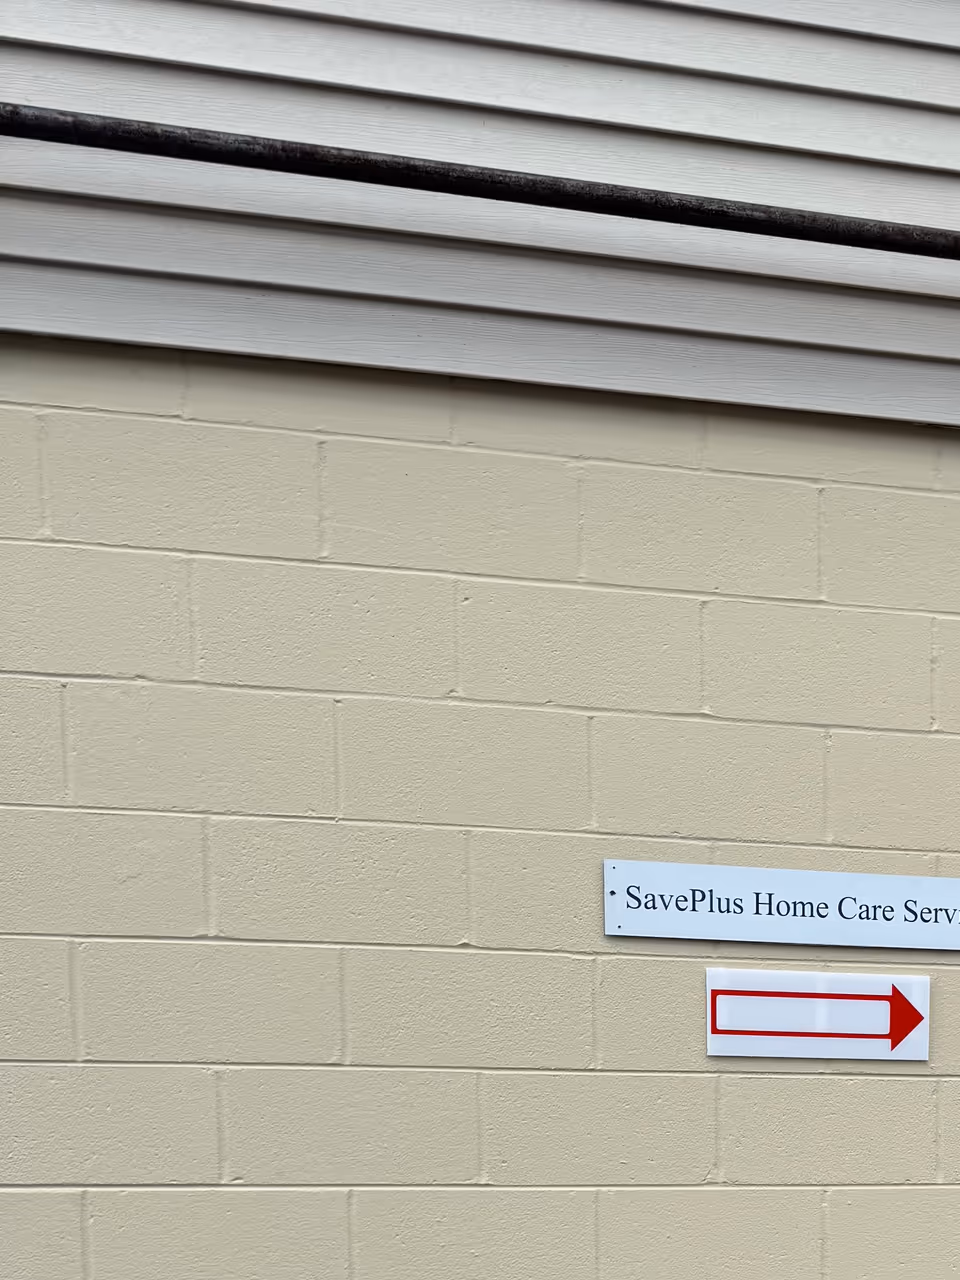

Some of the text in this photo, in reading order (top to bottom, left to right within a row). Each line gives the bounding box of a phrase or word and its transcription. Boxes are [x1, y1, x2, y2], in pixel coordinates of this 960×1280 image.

[625, 884, 744, 915] SavePlus
[753, 891, 830, 919] Home
[837, 896, 896, 922] Care
